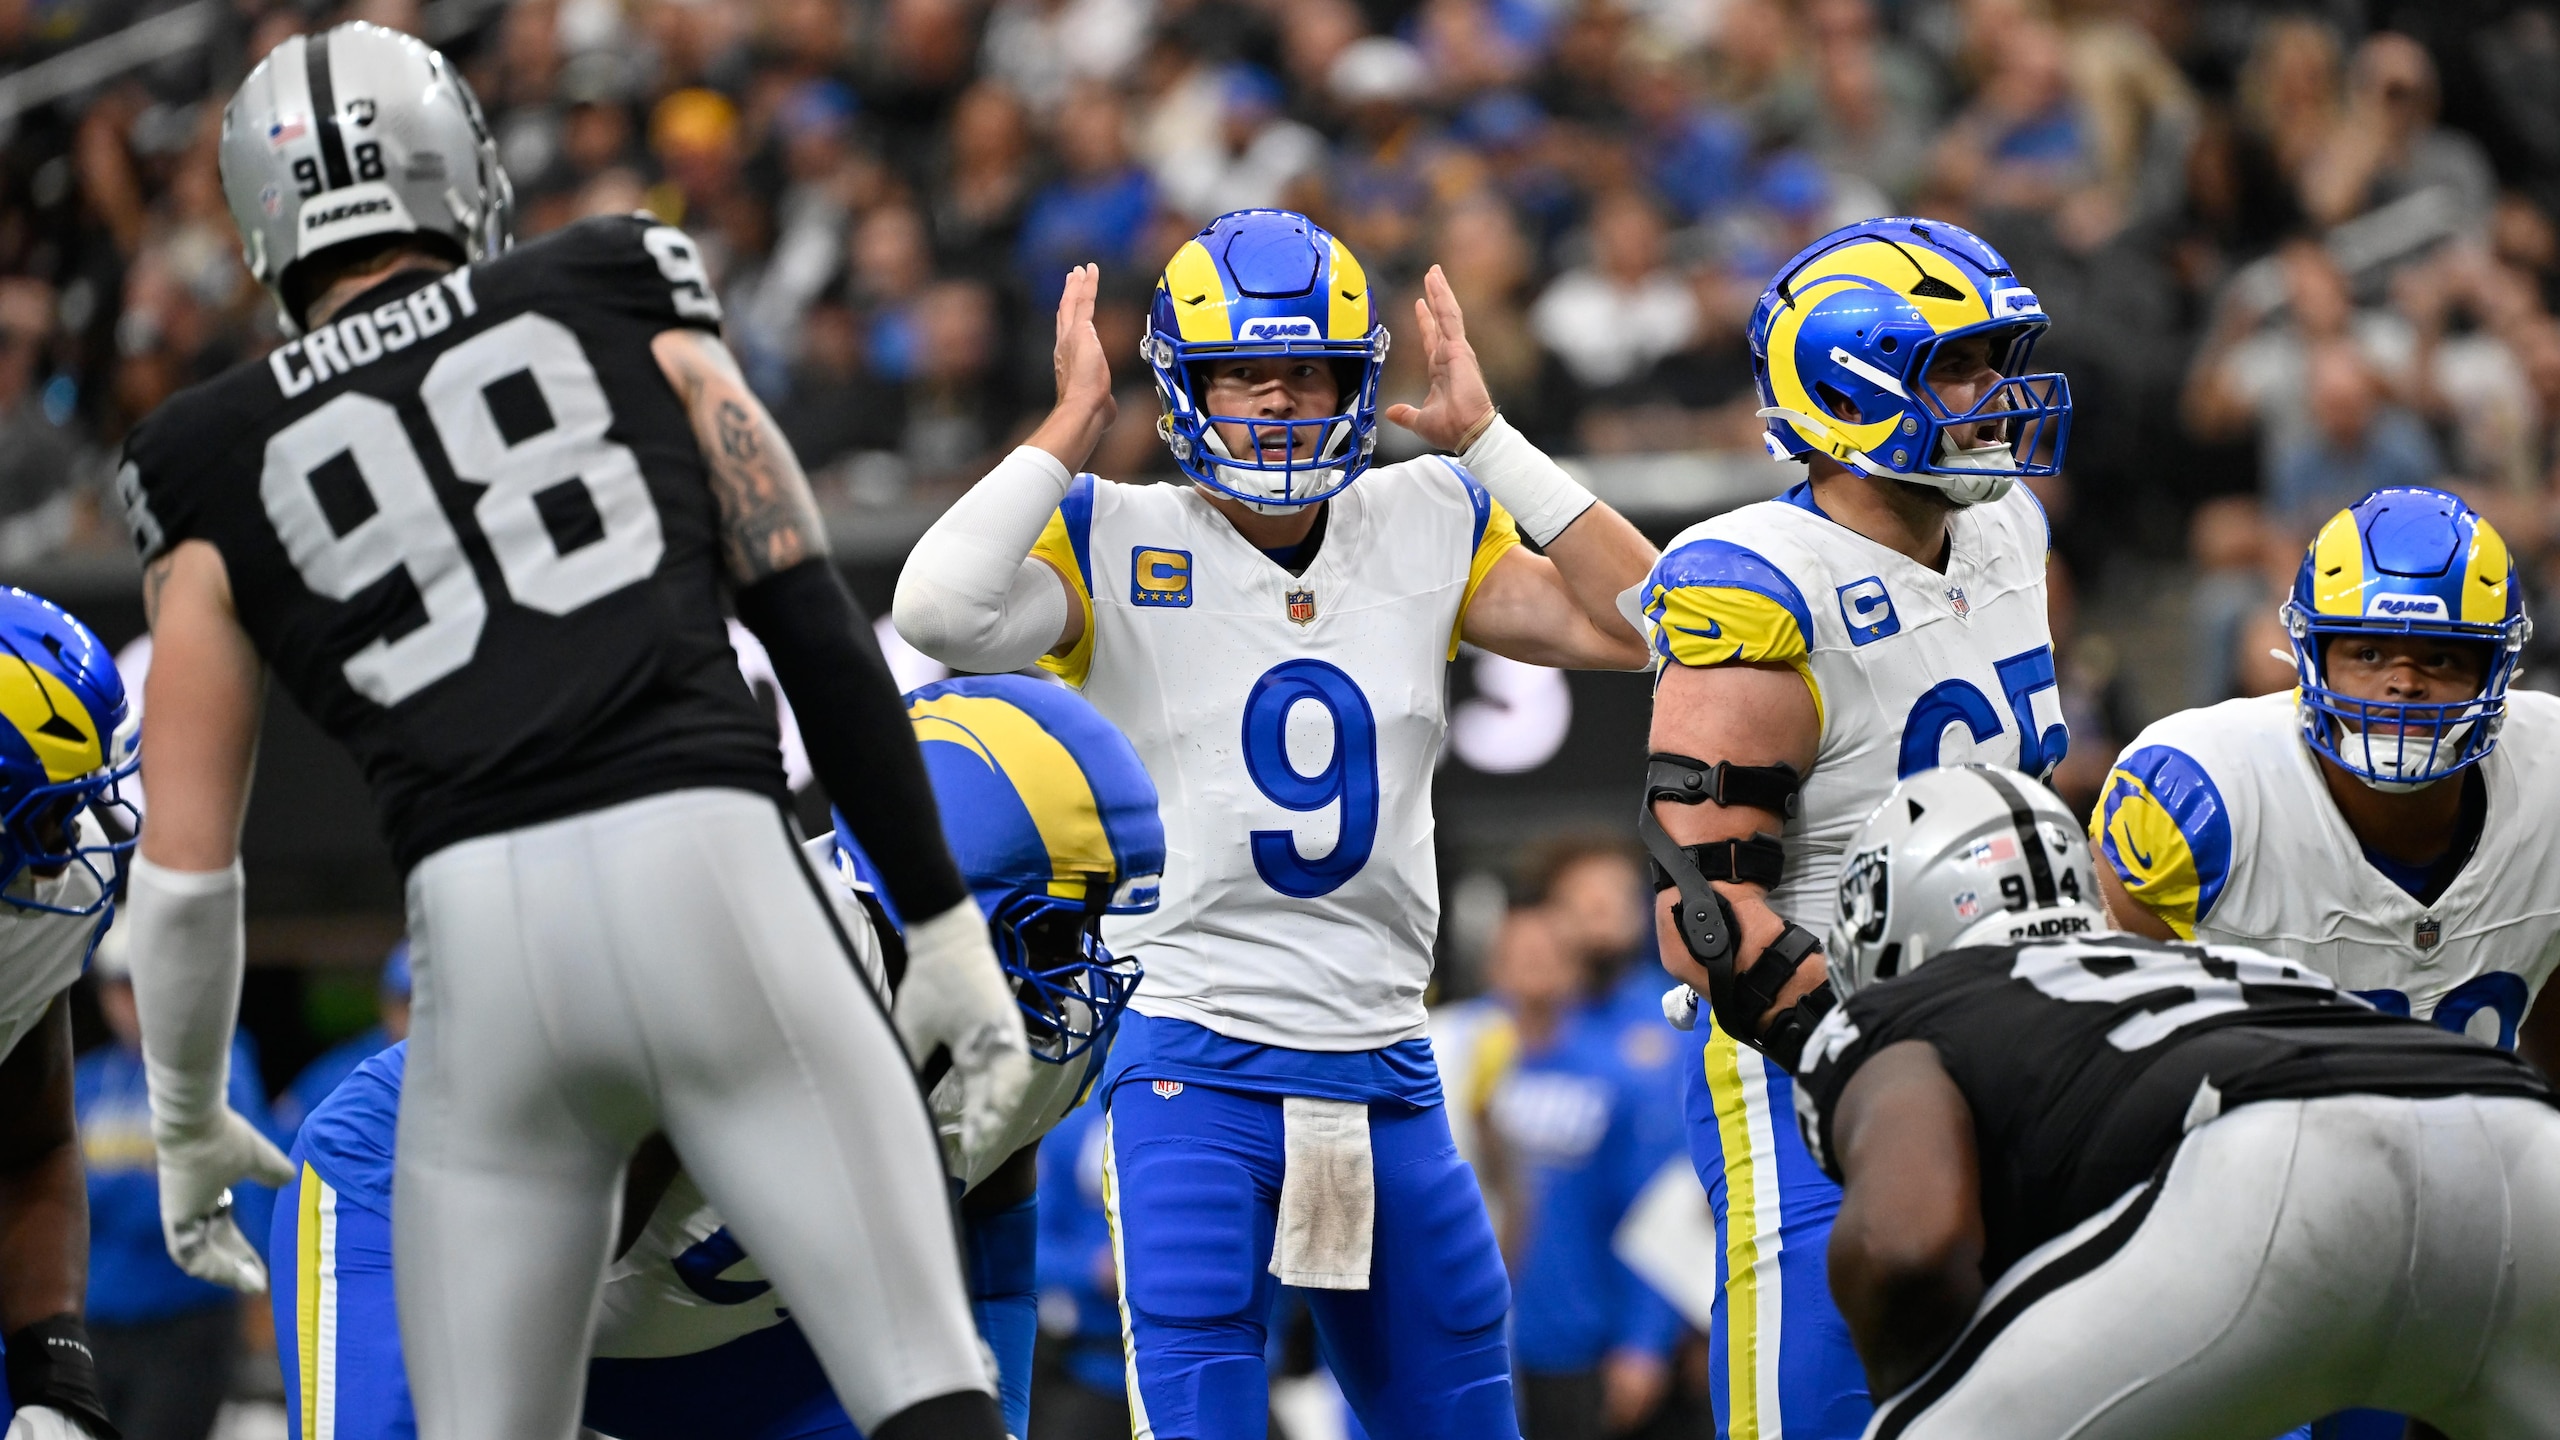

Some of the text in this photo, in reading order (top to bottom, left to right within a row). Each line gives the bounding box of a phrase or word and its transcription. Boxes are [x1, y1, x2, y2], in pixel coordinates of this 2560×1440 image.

[305, 198, 393, 230] RAIDERS
[269, 265, 478, 398] CROSBY
[1249, 324, 1311, 340] RAMS
[259, 310, 666, 708] 98
[1137, 550, 1188, 592] C
[1291, 604, 1312, 619] NFL
[1841, 581, 1890, 629] C
[2377, 600, 2439, 615] RAMS
[1242, 658, 1380, 899] 9
[1158, 1080, 1178, 1092] NFL
